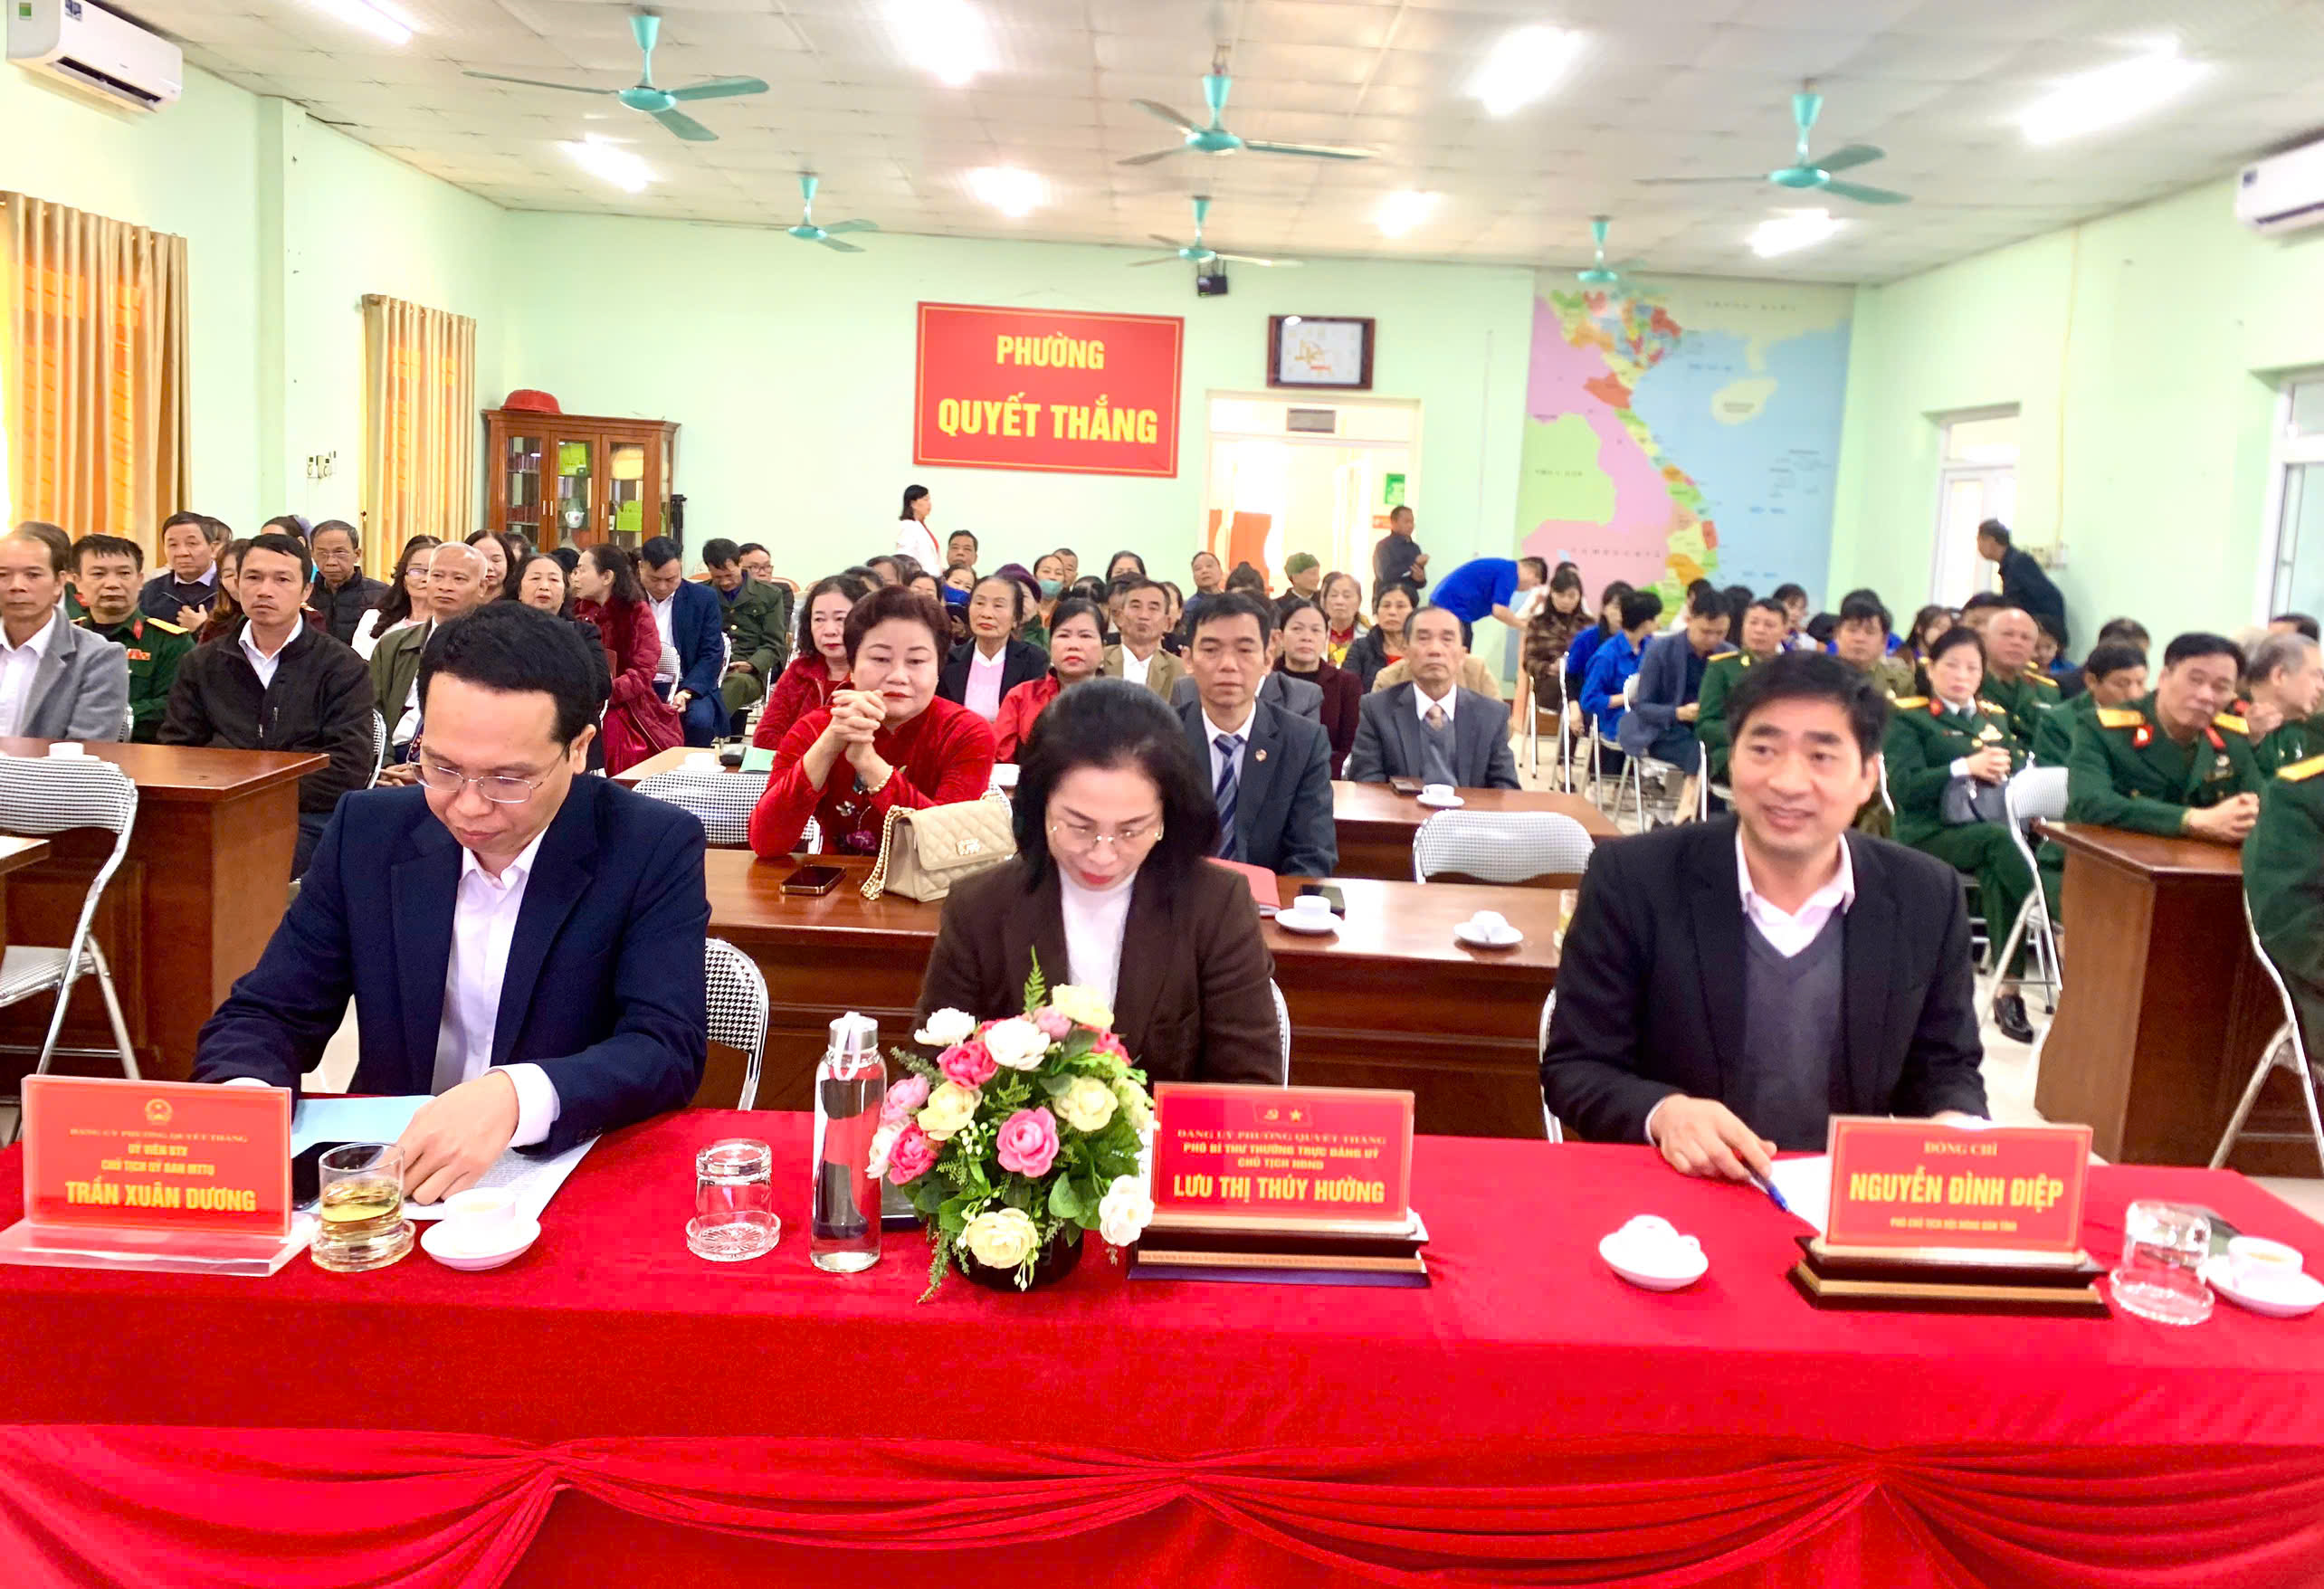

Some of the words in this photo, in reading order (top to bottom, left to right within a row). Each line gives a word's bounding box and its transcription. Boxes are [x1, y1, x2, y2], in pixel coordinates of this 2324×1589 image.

[996, 331, 1105, 369] PHƯỜNG
[938, 392, 1042, 436] QUYẾT
[1050, 394, 1158, 443] THẮNG
[1183, 1141, 1206, 1154] PHÓ
[1224, 1143, 1246, 1155] THƯ
[1237, 1156, 1260, 1168] CHỦ
[1264, 1157, 1290, 1169] TỊCH
[1970, 1140, 1997, 1156] CHÍ
[125, 1181, 181, 1208] XUÂN
[186, 1187, 256, 1212] DƯƠNG
[1174, 1174, 1213, 1197] LƯU
[1219, 1176, 1251, 1204] THỊ
[1256, 1174, 1309, 1202] THÚY
[1849, 1165, 1943, 1204] NGUYỄN
[1948, 1169, 2005, 1206] ĐÌNH
[2010, 1173, 2064, 1213] ĐIỆP
